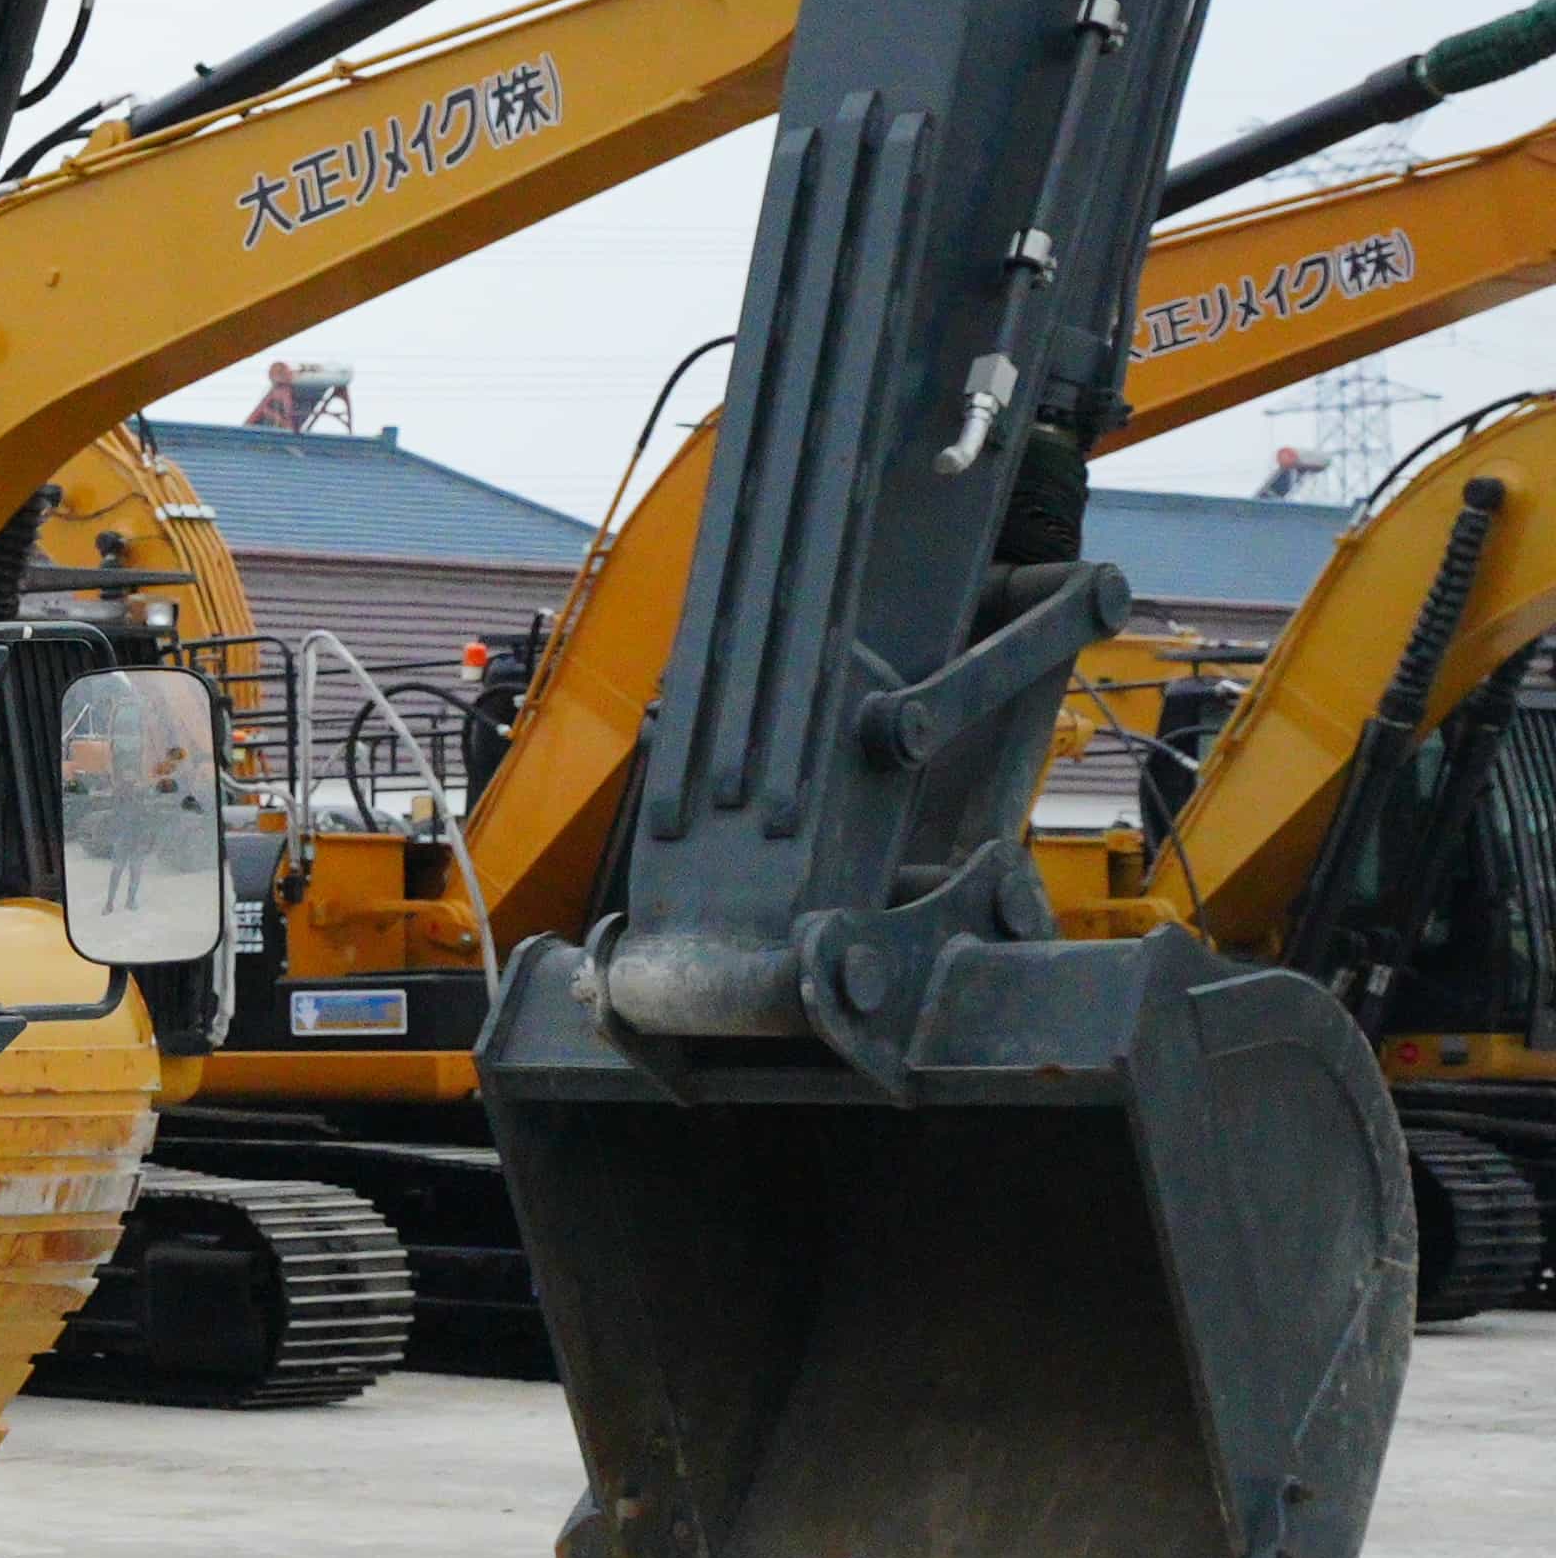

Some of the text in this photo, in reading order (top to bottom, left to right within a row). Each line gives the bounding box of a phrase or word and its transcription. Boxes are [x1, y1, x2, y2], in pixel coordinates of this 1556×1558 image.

[238, 52, 561, 249] 大正リメイク(株)
[1129, 229, 1414, 362] 正リメイク(株)
